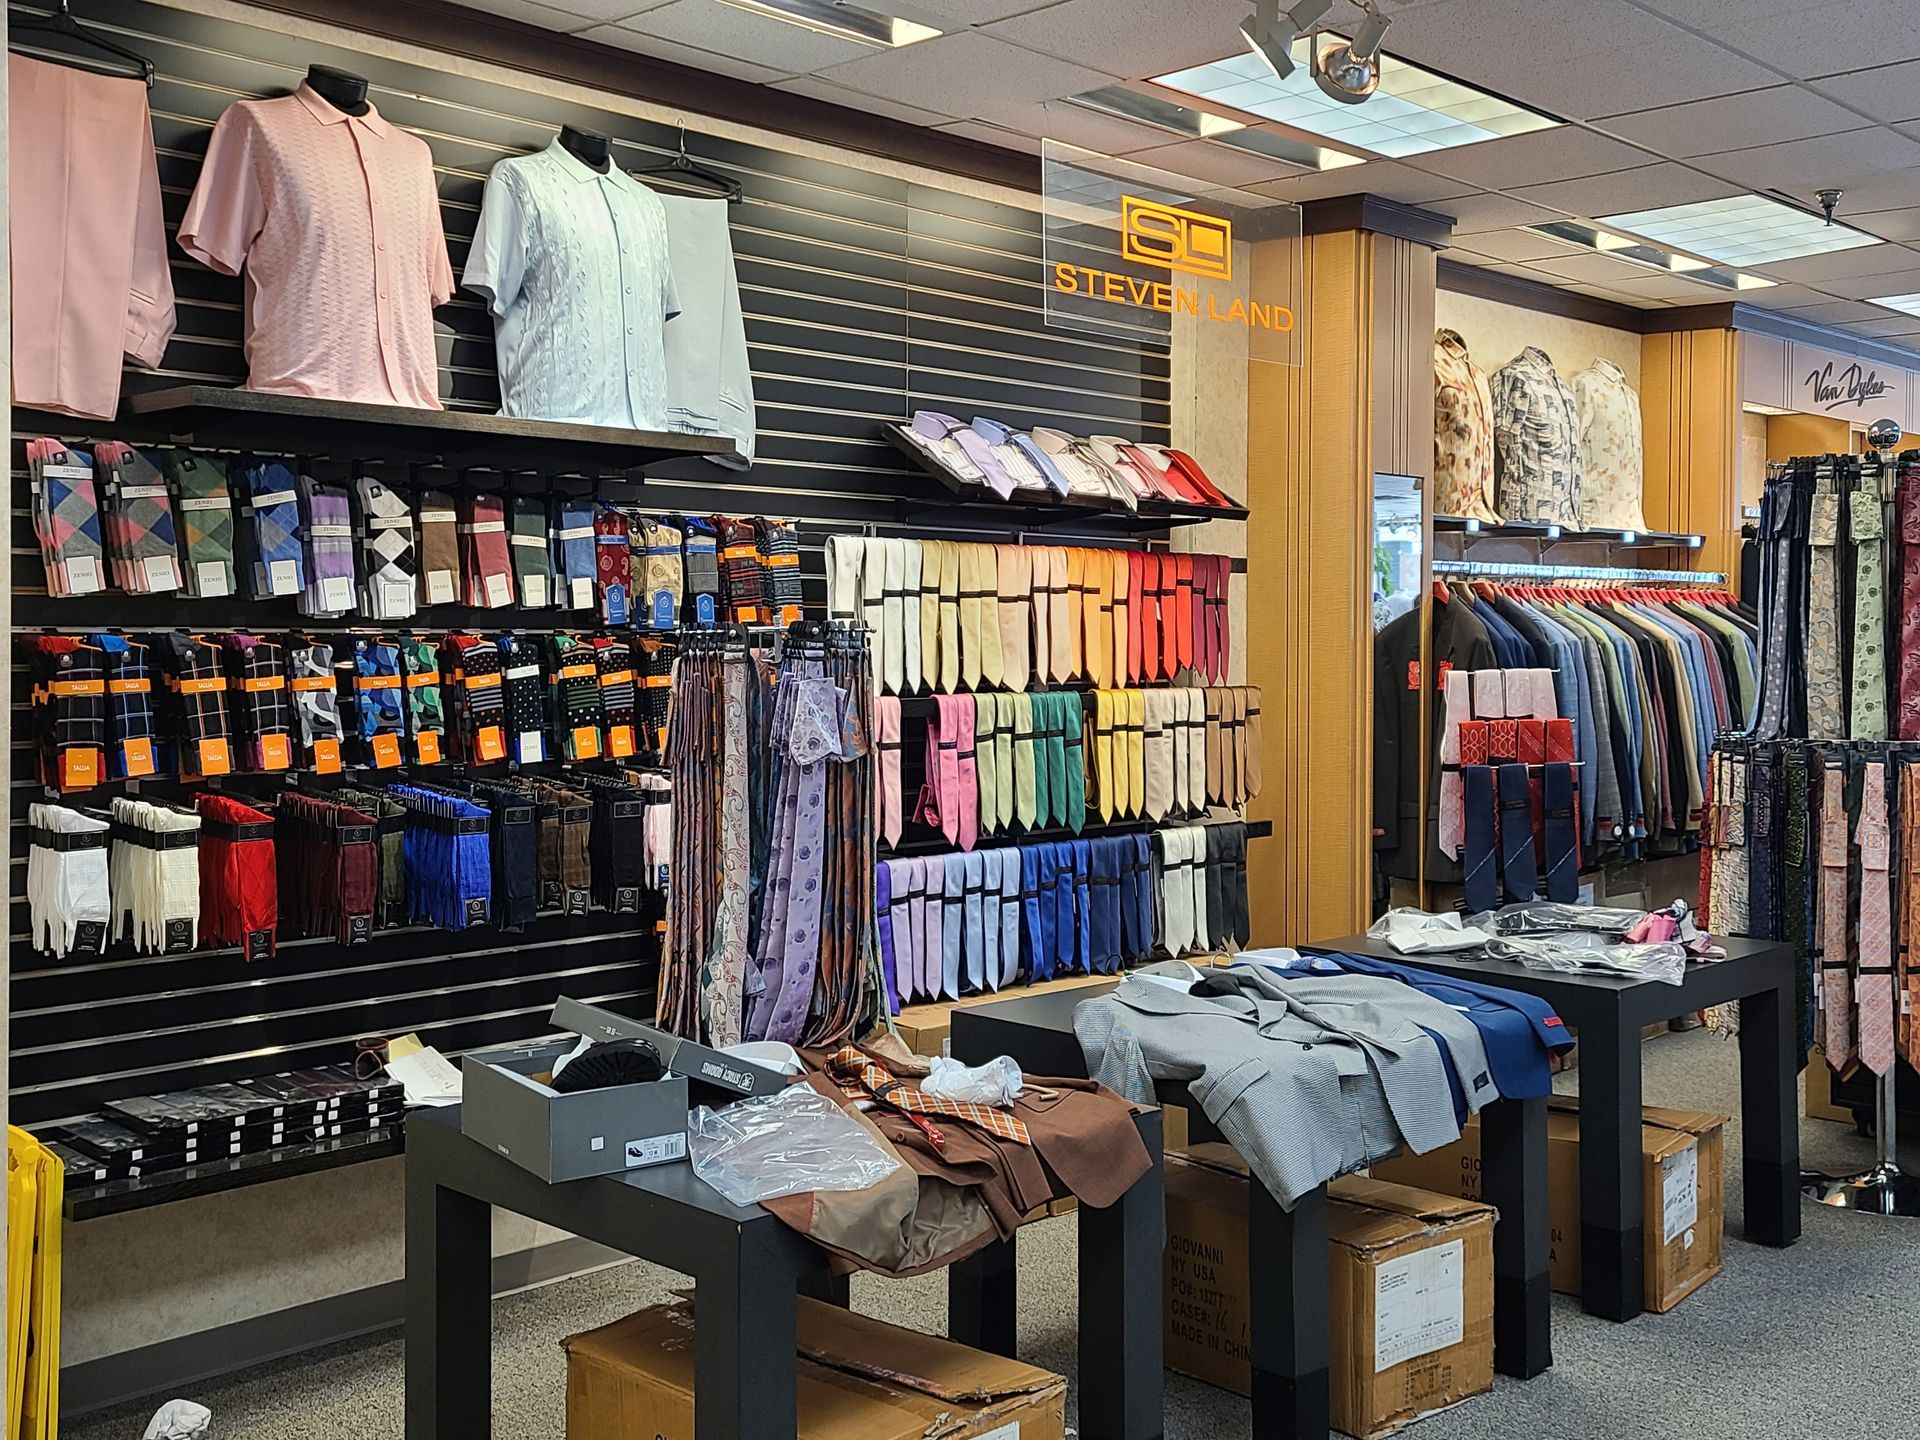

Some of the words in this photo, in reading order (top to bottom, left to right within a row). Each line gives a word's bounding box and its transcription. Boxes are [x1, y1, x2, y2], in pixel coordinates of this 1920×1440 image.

[1055, 263, 1197, 316] STEVEN
[1209, 292, 1294, 332] LAND
[1804, 362, 1845, 402] Van
[1838, 363, 1895, 407] Dykes
[1462, 1174, 1478, 1188] NY
[1170, 1235, 1223, 1266] GIOVANNI
[1171, 1256, 1185, 1273] NY
[1193, 1263, 1216, 1284] USA
[1172, 1320, 1203, 1345] MADE
[1208, 1333, 1219, 1350] IN
